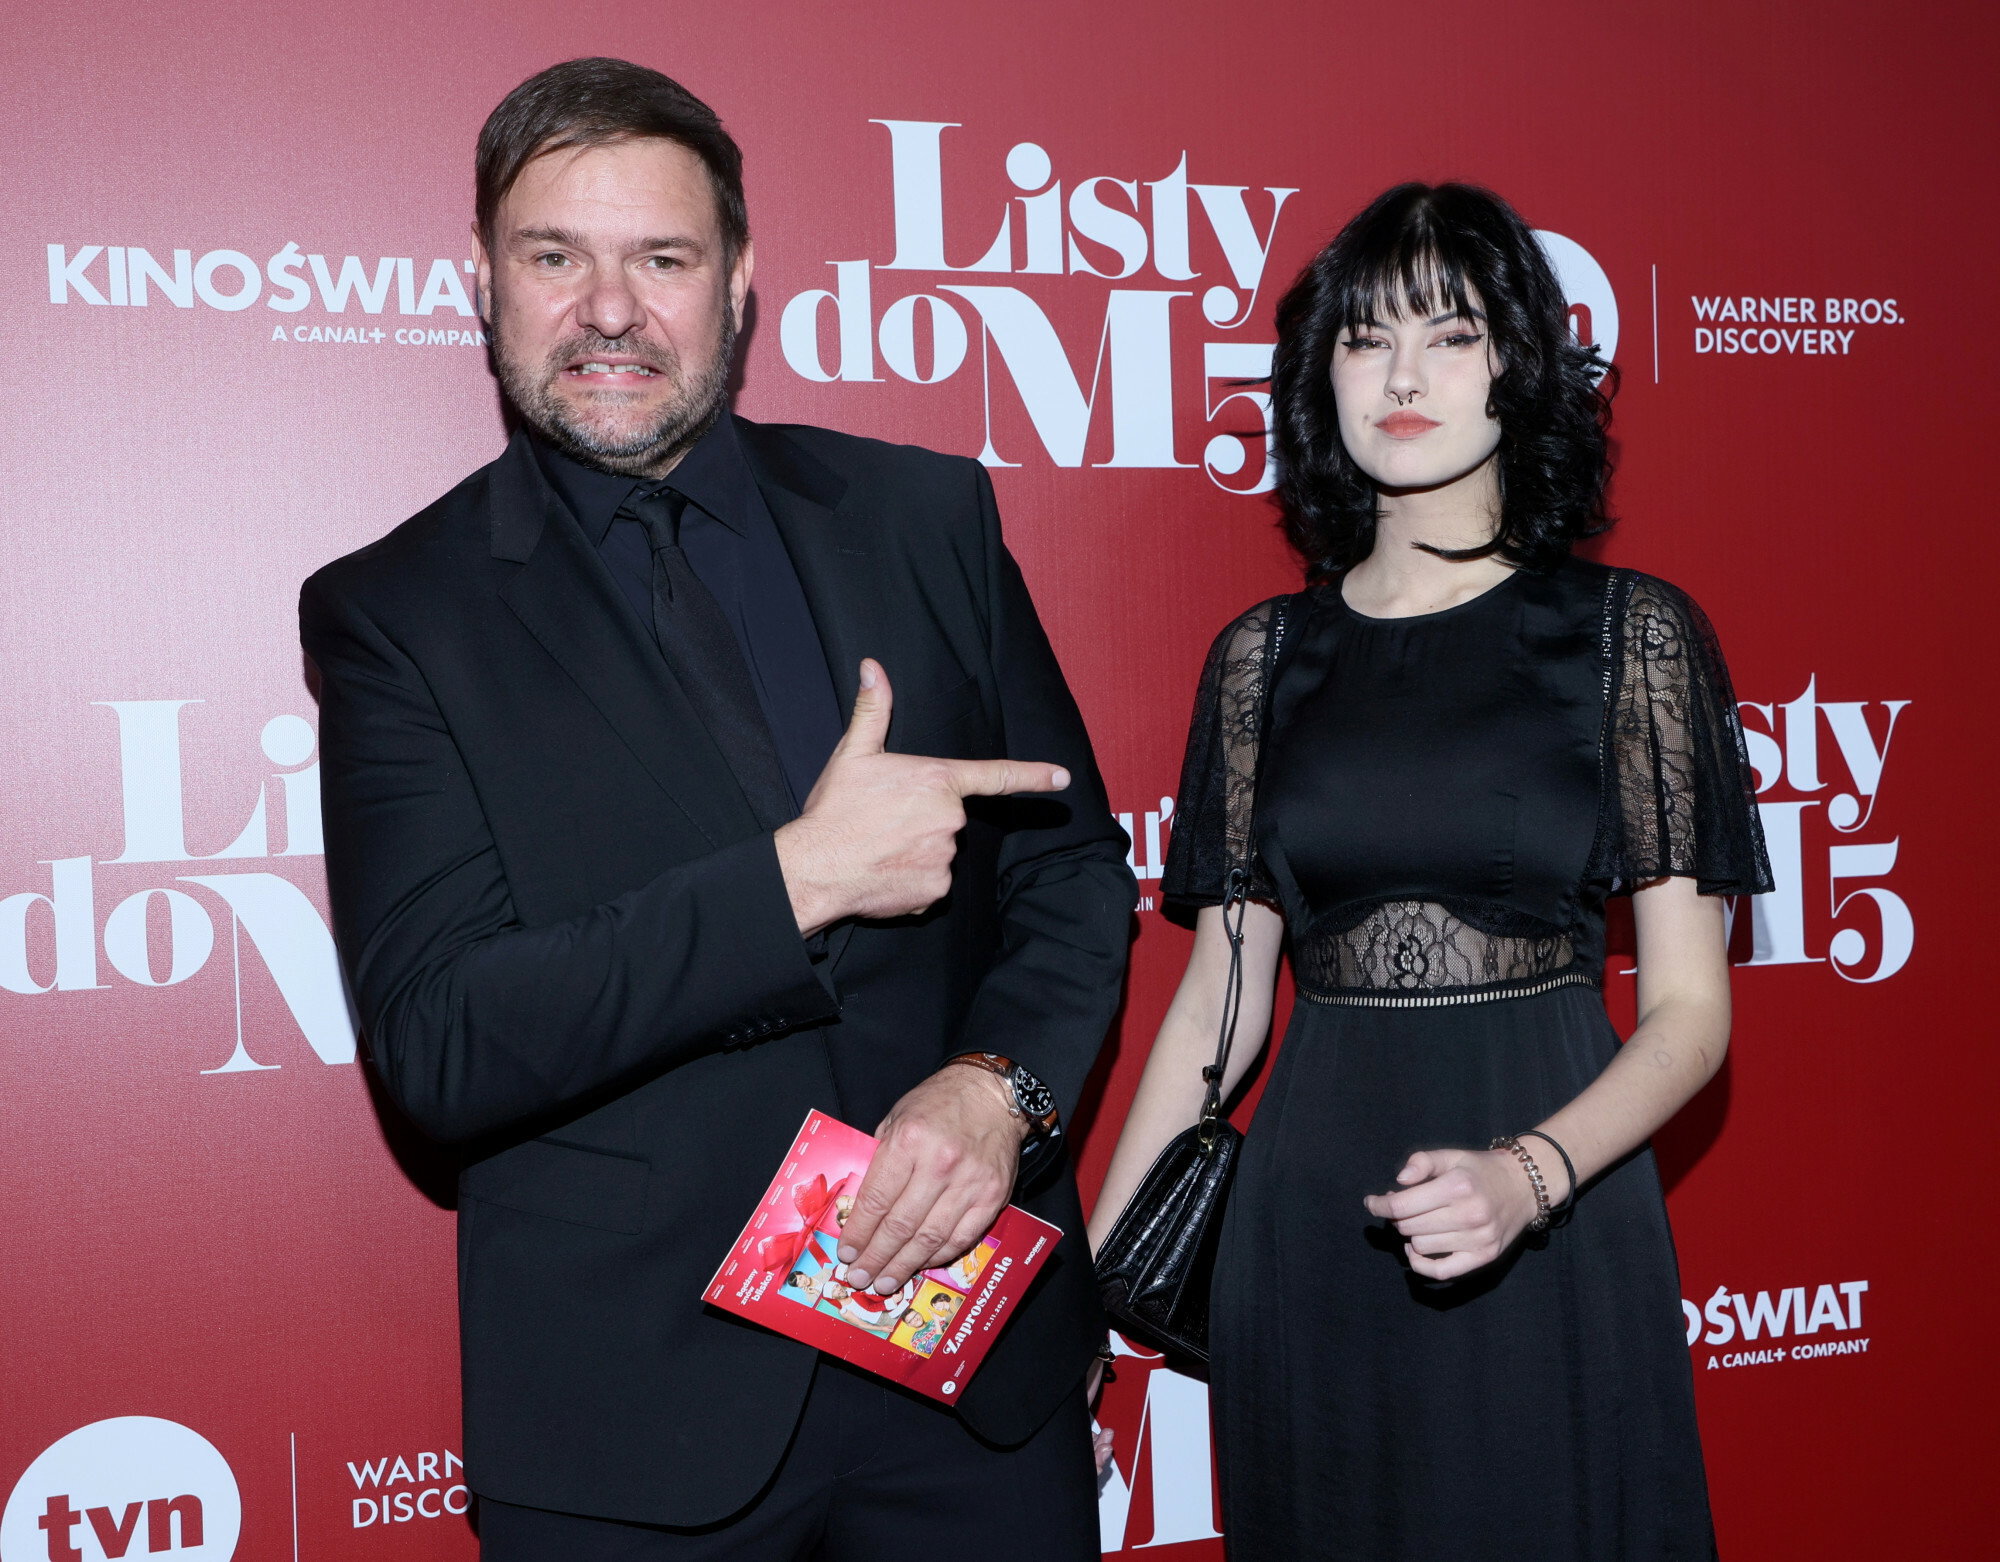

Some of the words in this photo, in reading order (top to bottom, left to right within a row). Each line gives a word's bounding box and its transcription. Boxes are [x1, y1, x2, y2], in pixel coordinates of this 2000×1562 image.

[868, 119, 1300, 329] Listy
[1691, 296, 1817, 323] WARNER
[1825, 298, 1905, 324] BROS.
[271, 325, 288, 342] A
[293, 326, 387, 344] CANAL+
[1695, 328, 1855, 355] DISCOVERY
[943, 1256, 1013, 1354] Zaproszenie
[1707, 1356, 1719, 1370] A
[1722, 1347, 1786, 1368] CANAL+
[1791, 1338, 1870, 1360] COMPANY
[38, 1493, 204, 1562] tvn
